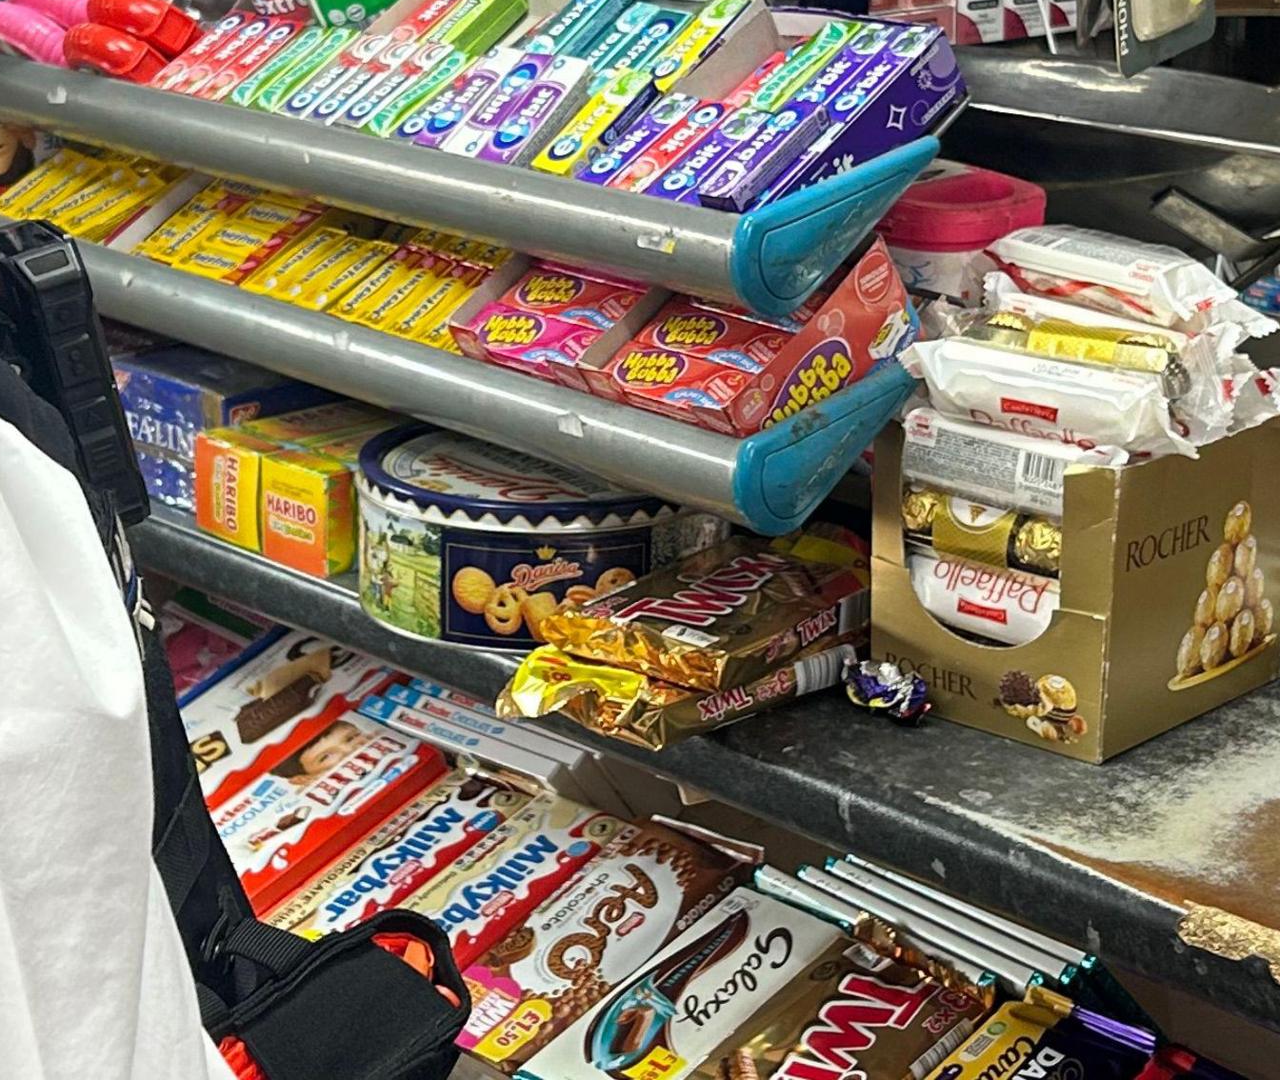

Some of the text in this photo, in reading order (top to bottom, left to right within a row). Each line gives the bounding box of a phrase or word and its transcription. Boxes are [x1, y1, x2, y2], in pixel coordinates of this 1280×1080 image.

[291, 66, 344, 110] Orbit
[320, 73, 371, 115] Orbit
[349, 75, 404, 118] Orbit
[835, 62, 891, 111] Orbit
[591, 127, 650, 173] Orbit
[660, 106, 718, 155] Orbit
[663, 141, 721, 190] Orbit
[525, 275, 574, 294] Hubba
[527, 286, 575, 304] Bubba
[485, 315, 534, 333] Hubba
[486, 326, 540, 347] Bubba
[662, 314, 723, 333] Hubba
[666, 326, 719, 345] Bubba
[622, 351, 676, 373] Hubba
[625, 363, 681, 384] Bubba
[225, 454, 239, 532] HARIBO
[266, 492, 317, 525] HARIBO
[1125, 515, 1211, 572] ROCHER
[510, 558, 583, 592] Danisa
[610, 554, 787, 626] TWIX
[933, 559, 1053, 615] Raffaello
[797, 609, 838, 648] TWIX
[453, 711, 492, 733] CHOCOLATE
[696, 684, 753, 721] TWIX
[427, 721, 466, 745] CHOCOLATE
[325, 806, 464, 923] Milkybar
[541, 872, 611, 932] chocolate
[548, 863, 659, 981] Aero
[684, 926, 794, 1028] Galaxy
[496, 1009, 542, 1048] £1.50
